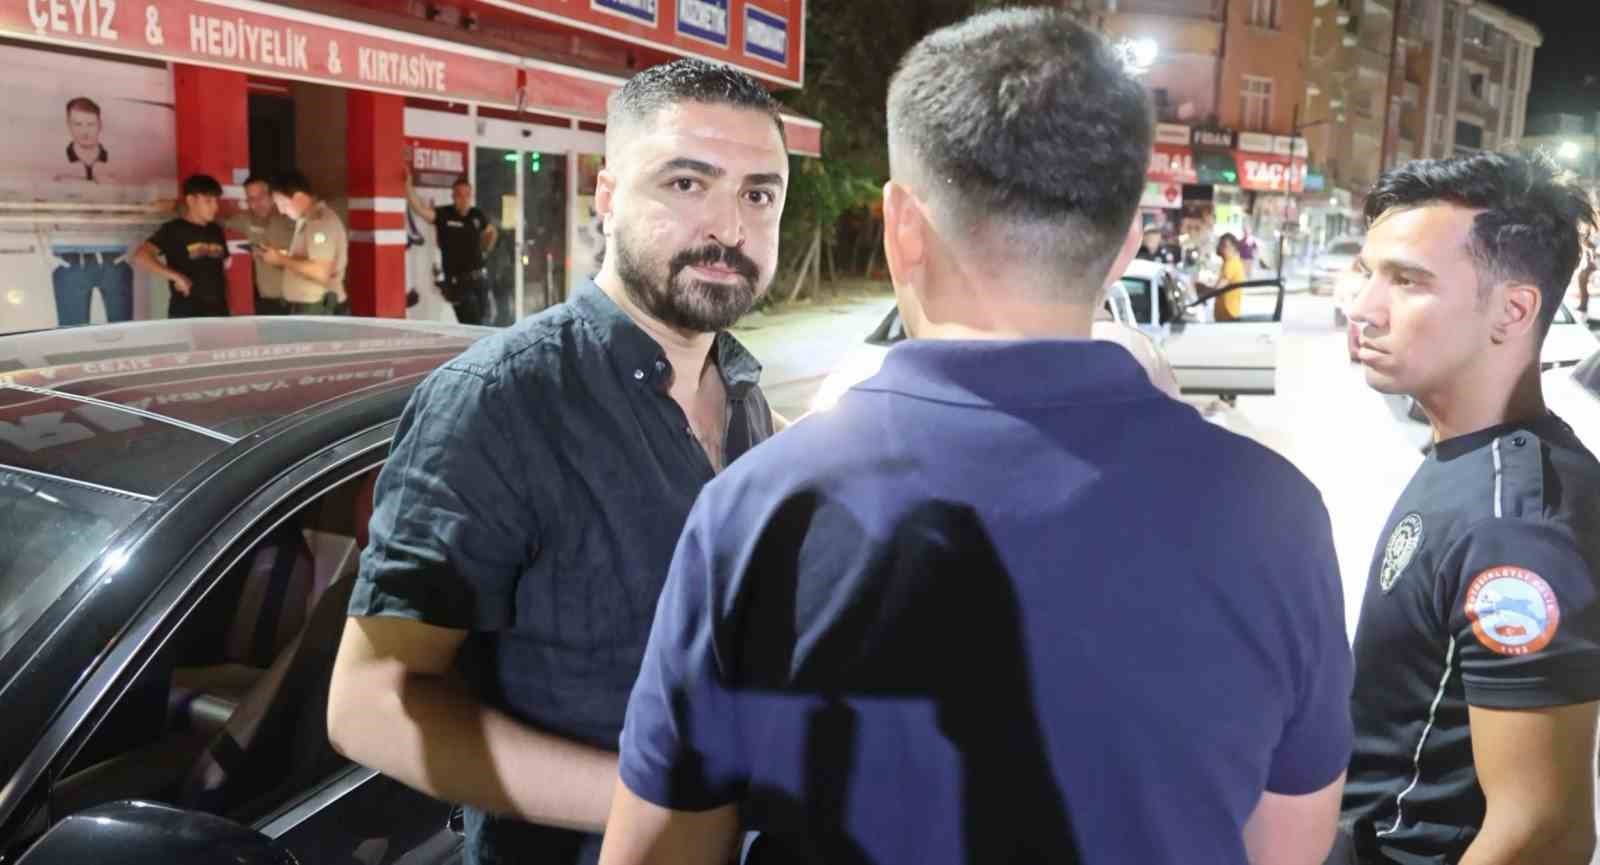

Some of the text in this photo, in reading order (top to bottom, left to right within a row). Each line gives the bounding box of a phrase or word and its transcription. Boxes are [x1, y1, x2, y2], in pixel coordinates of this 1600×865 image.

[145, 4, 165, 46] &
[189, 14, 309, 71] HEDİYELİK
[327, 40, 343, 74] &
[357, 47, 446, 90] KIRTASİYE
